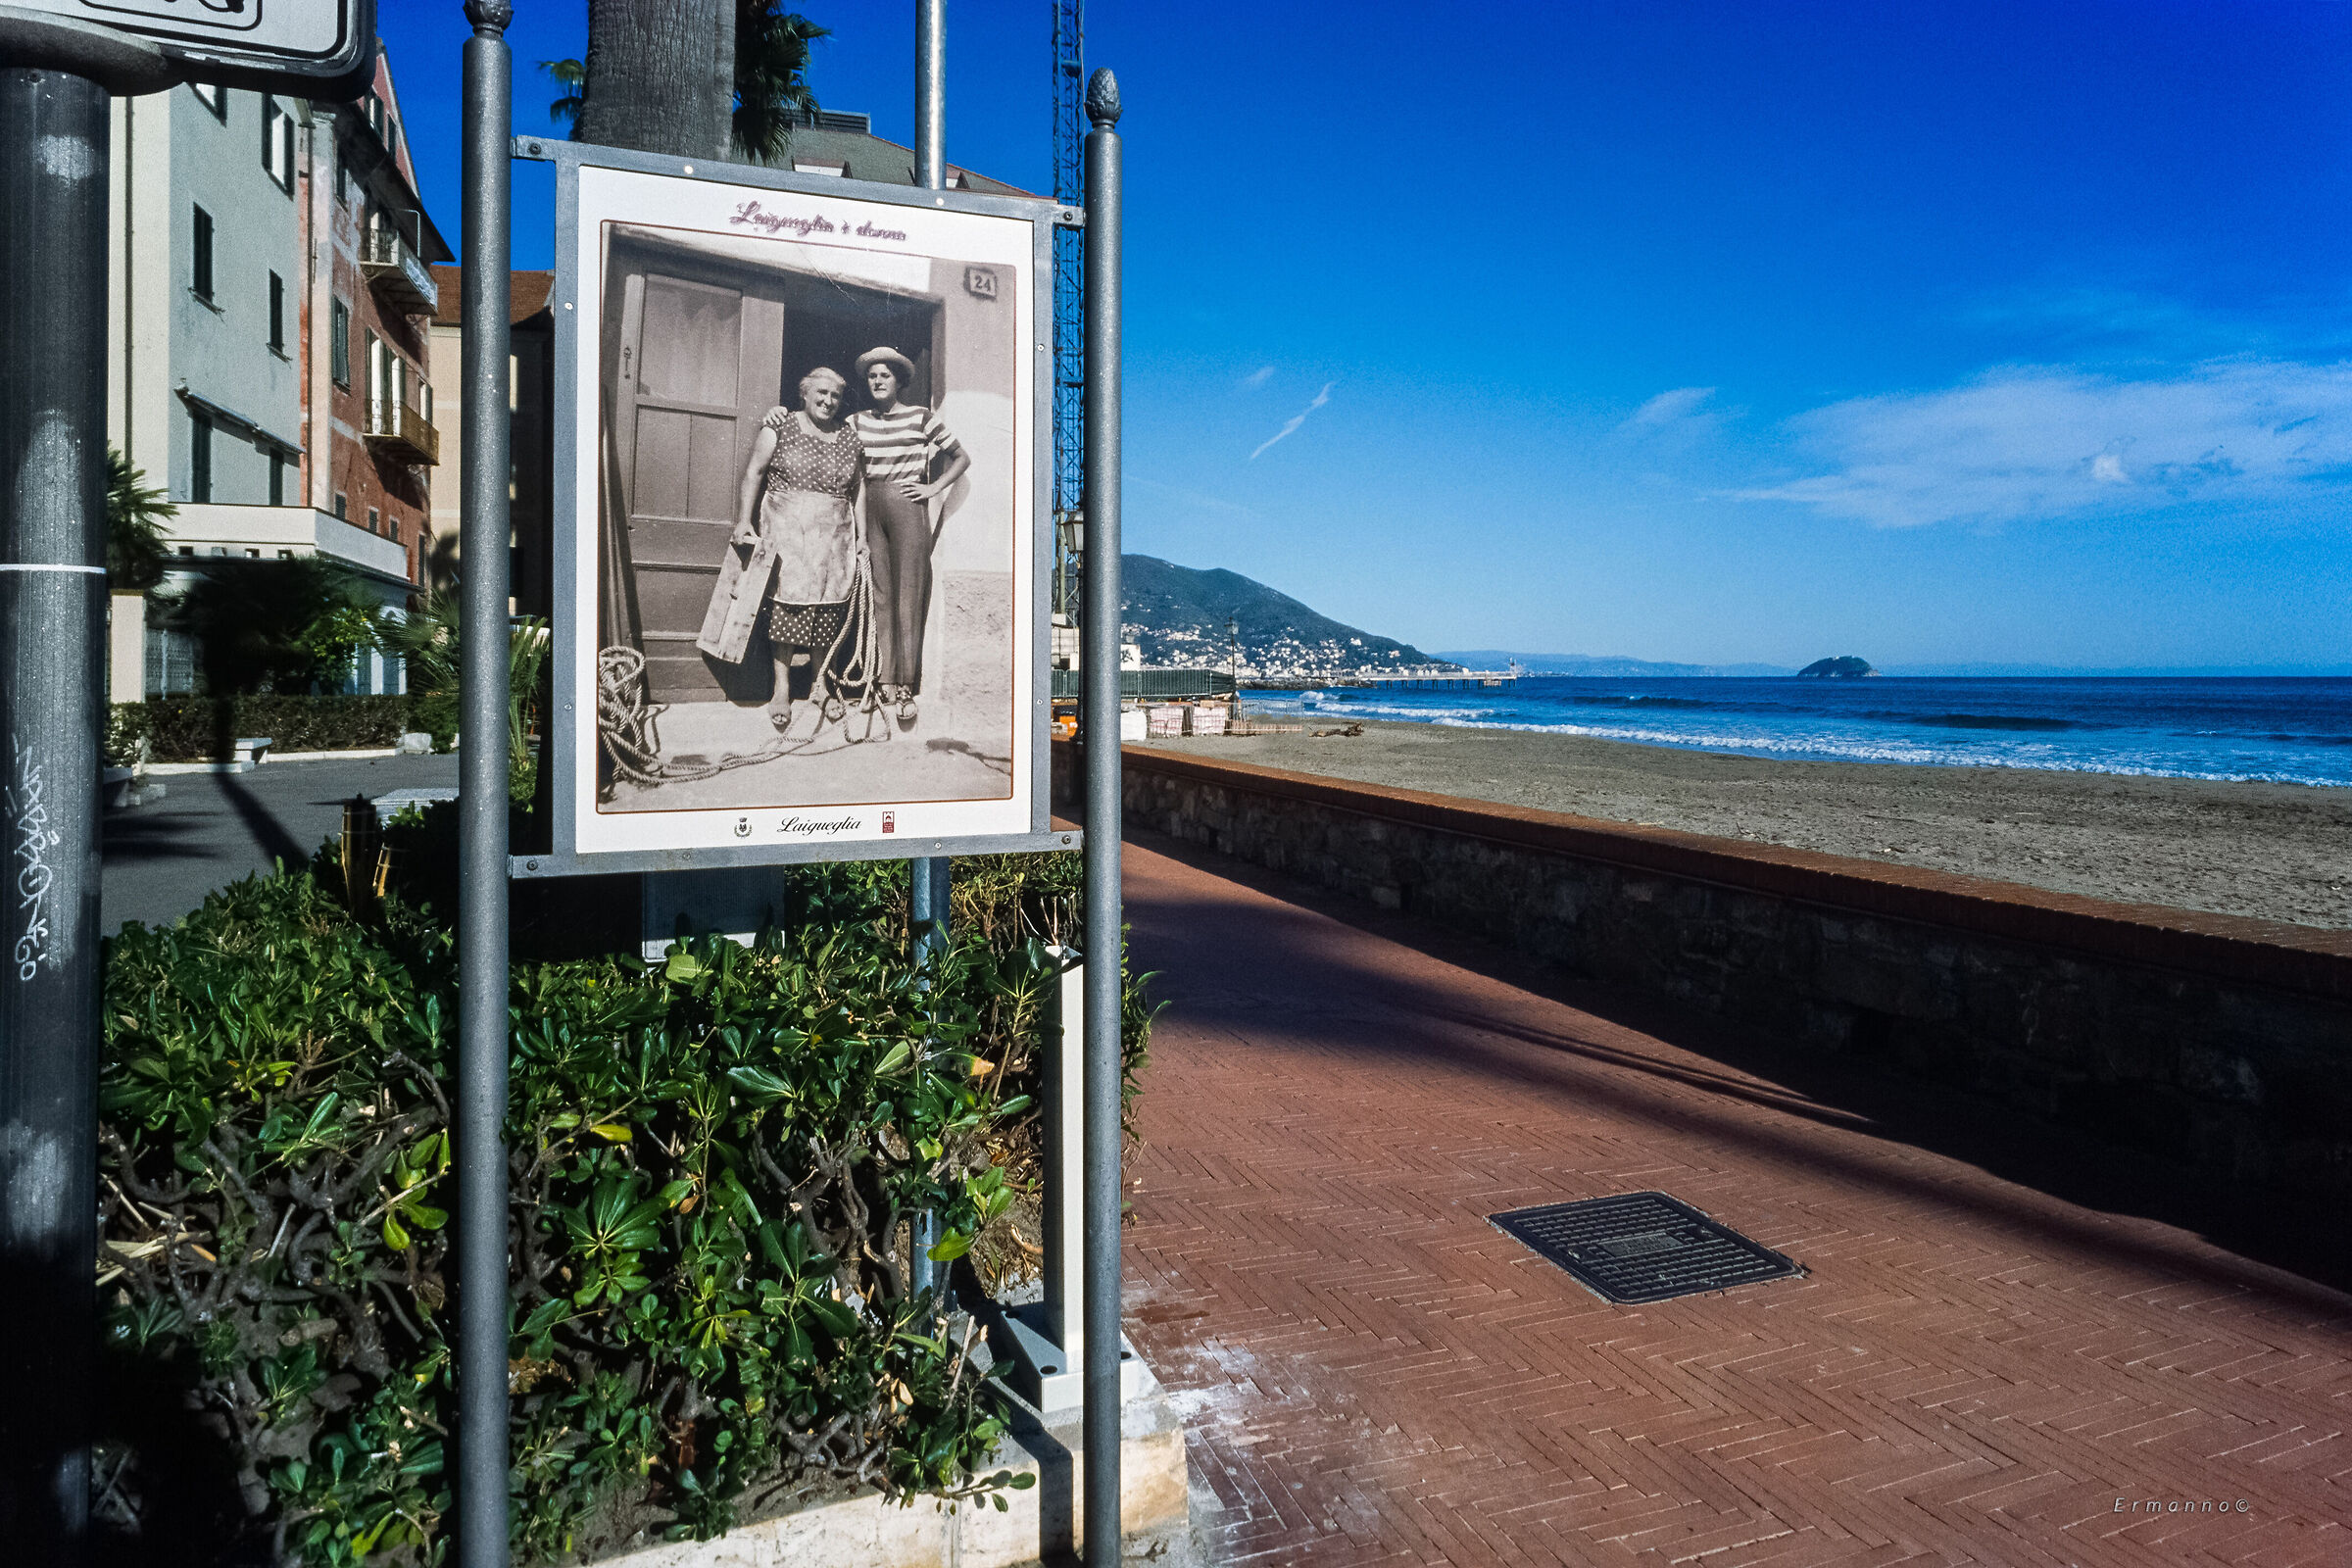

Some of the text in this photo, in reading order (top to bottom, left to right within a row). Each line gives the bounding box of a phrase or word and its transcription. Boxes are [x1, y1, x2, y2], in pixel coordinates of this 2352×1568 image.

[729, 200, 835, 237] Laigueglia
[856, 220, 907, 241] donna
[974, 274, 992, 292] 24
[776, 815, 862, 836] Laigueglia
